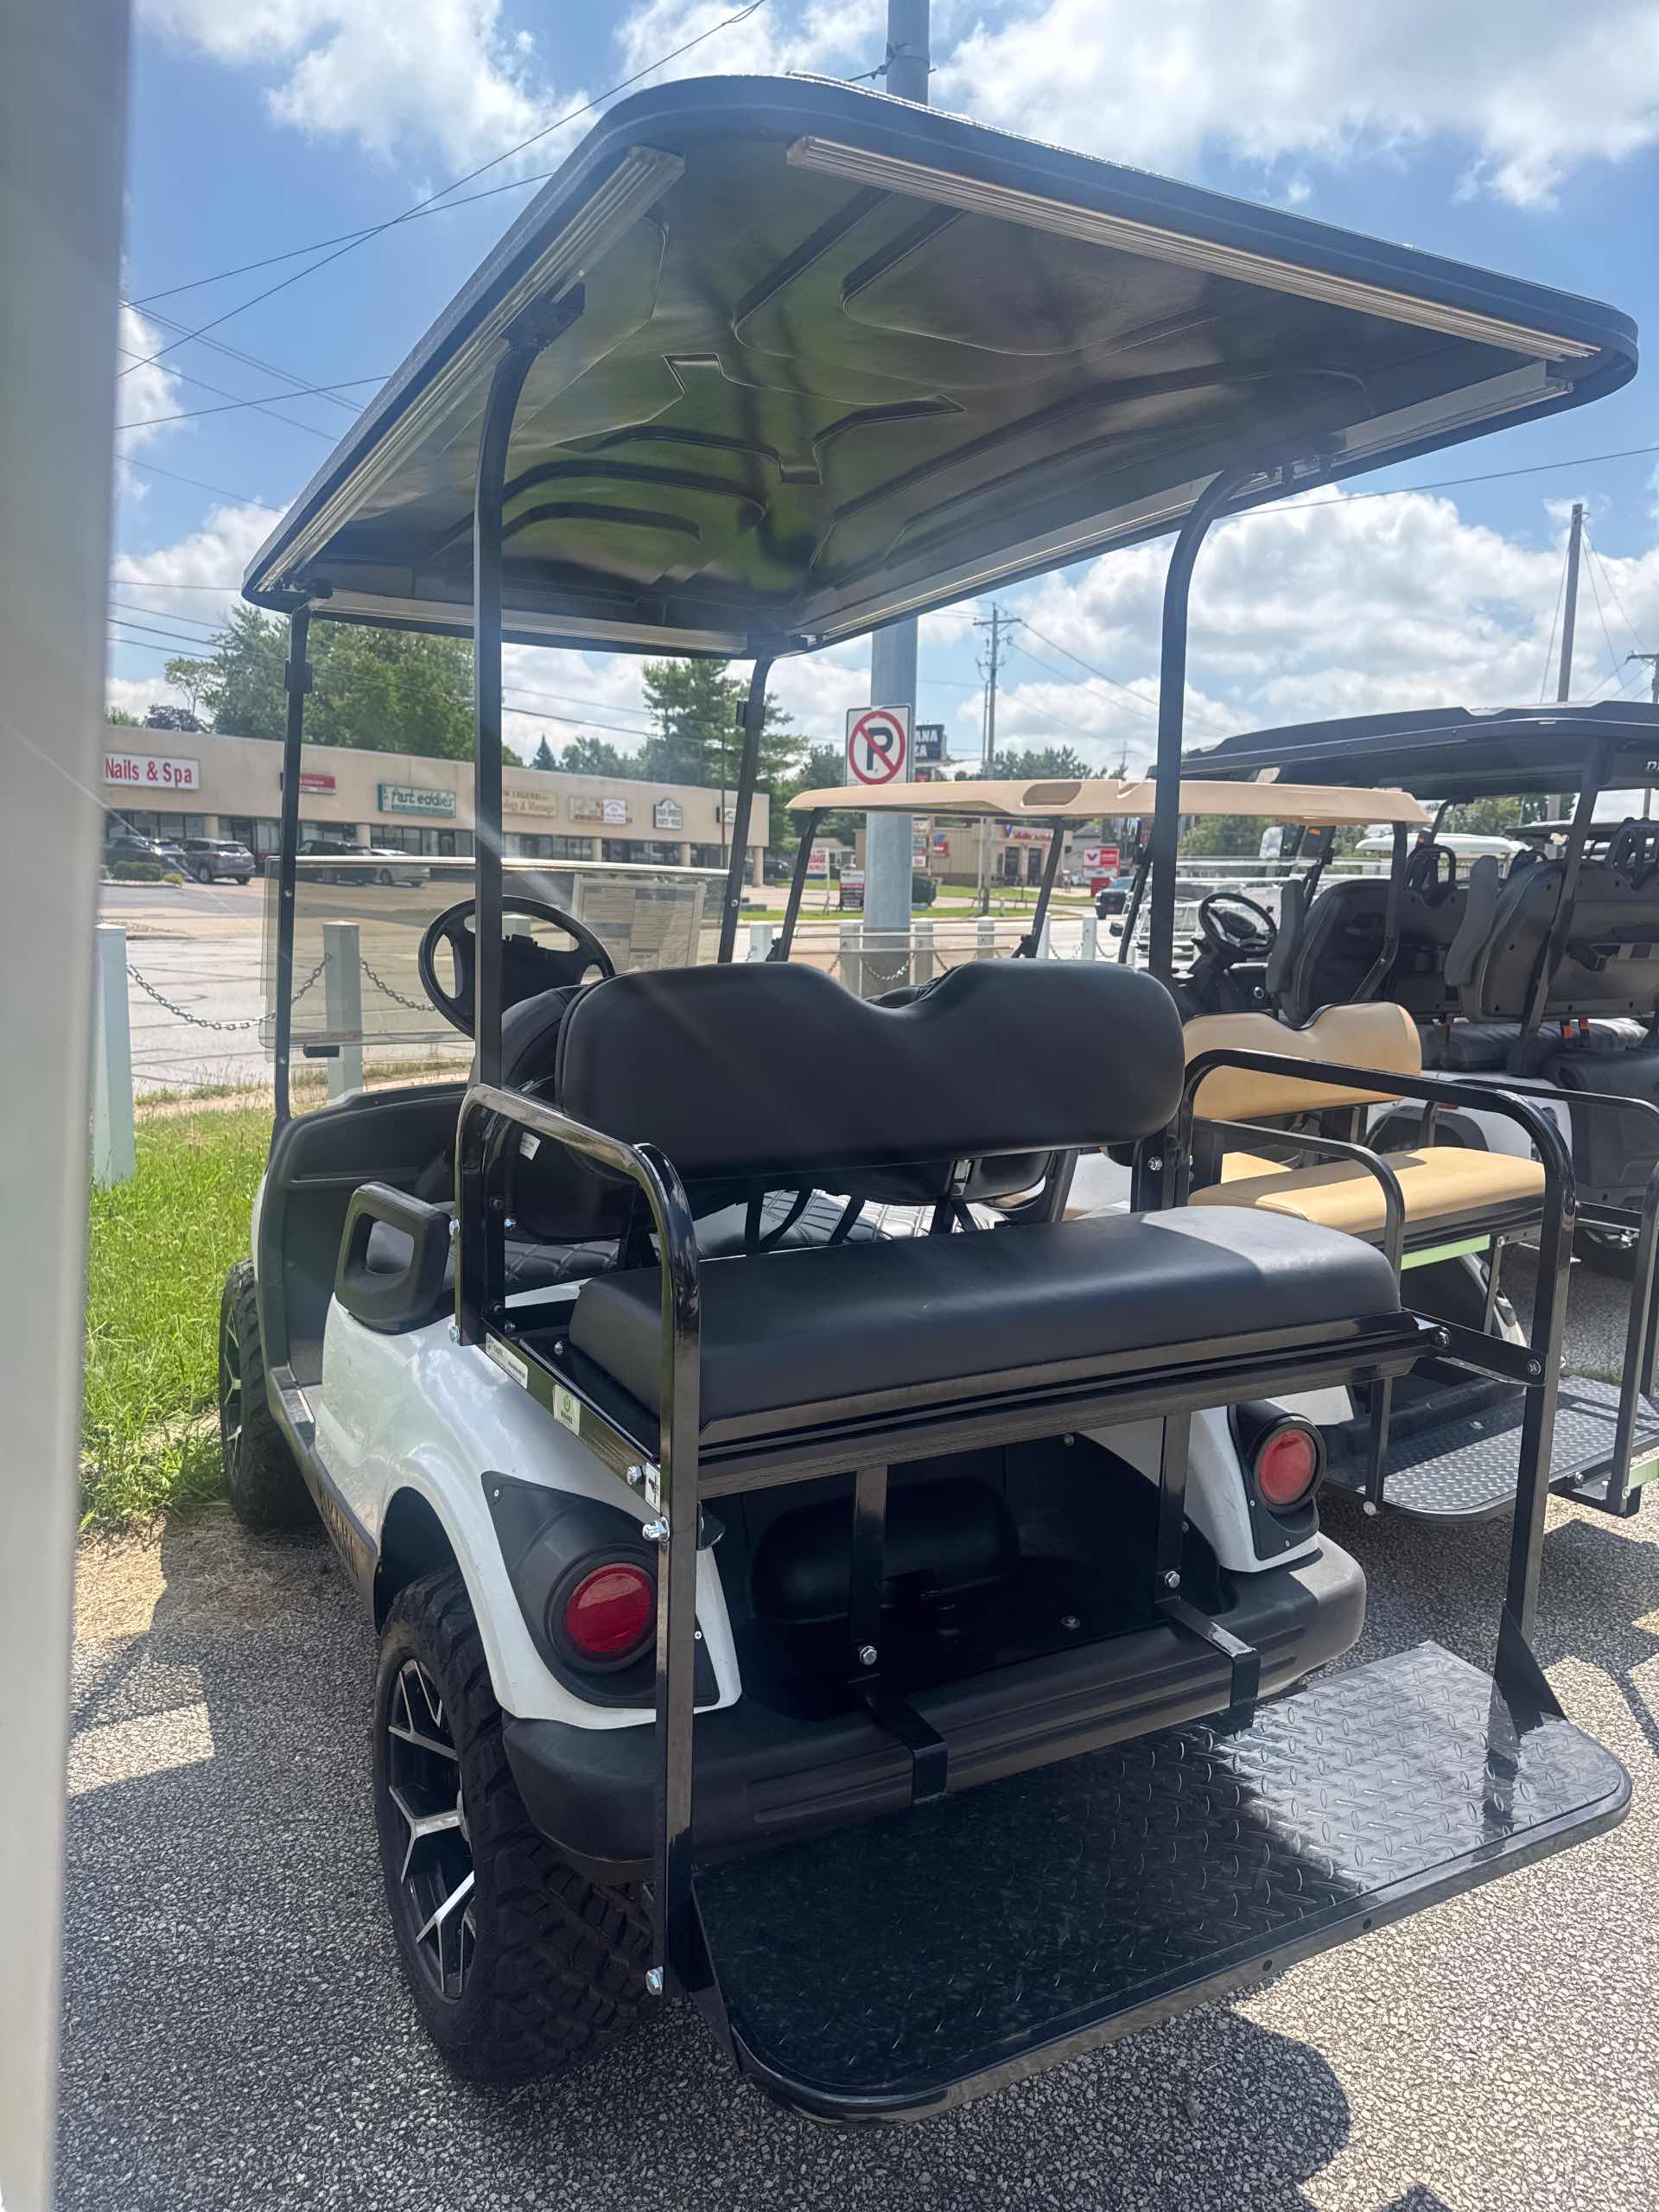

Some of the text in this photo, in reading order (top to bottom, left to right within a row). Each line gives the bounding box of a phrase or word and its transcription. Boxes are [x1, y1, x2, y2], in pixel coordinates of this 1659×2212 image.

[915, 730, 938, 742] ANA
[105, 758, 193, 788] Nails & Spa
